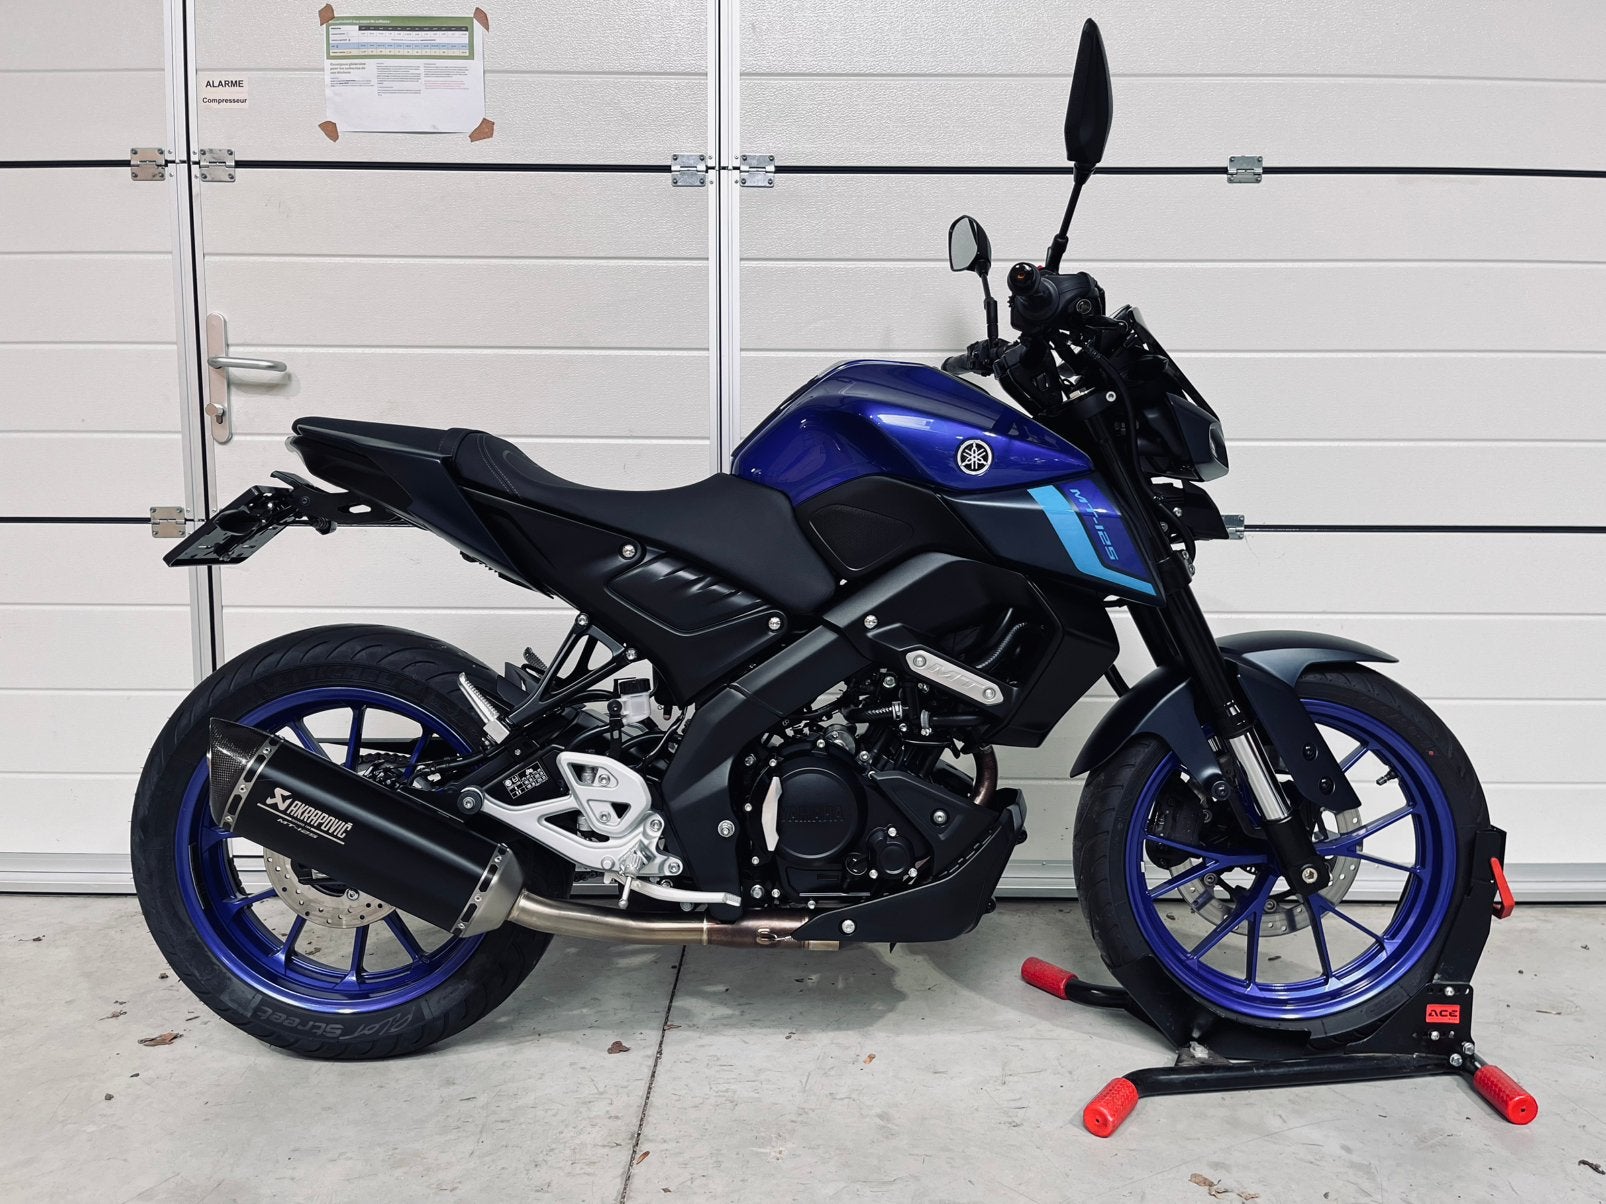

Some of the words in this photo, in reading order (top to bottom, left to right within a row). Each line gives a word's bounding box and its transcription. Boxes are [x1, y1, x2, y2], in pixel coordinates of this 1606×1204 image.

[205, 80, 244, 88] ALARME
[1069, 489, 1119, 561] MT-125
[1428, 1010, 1458, 1018] ACE
